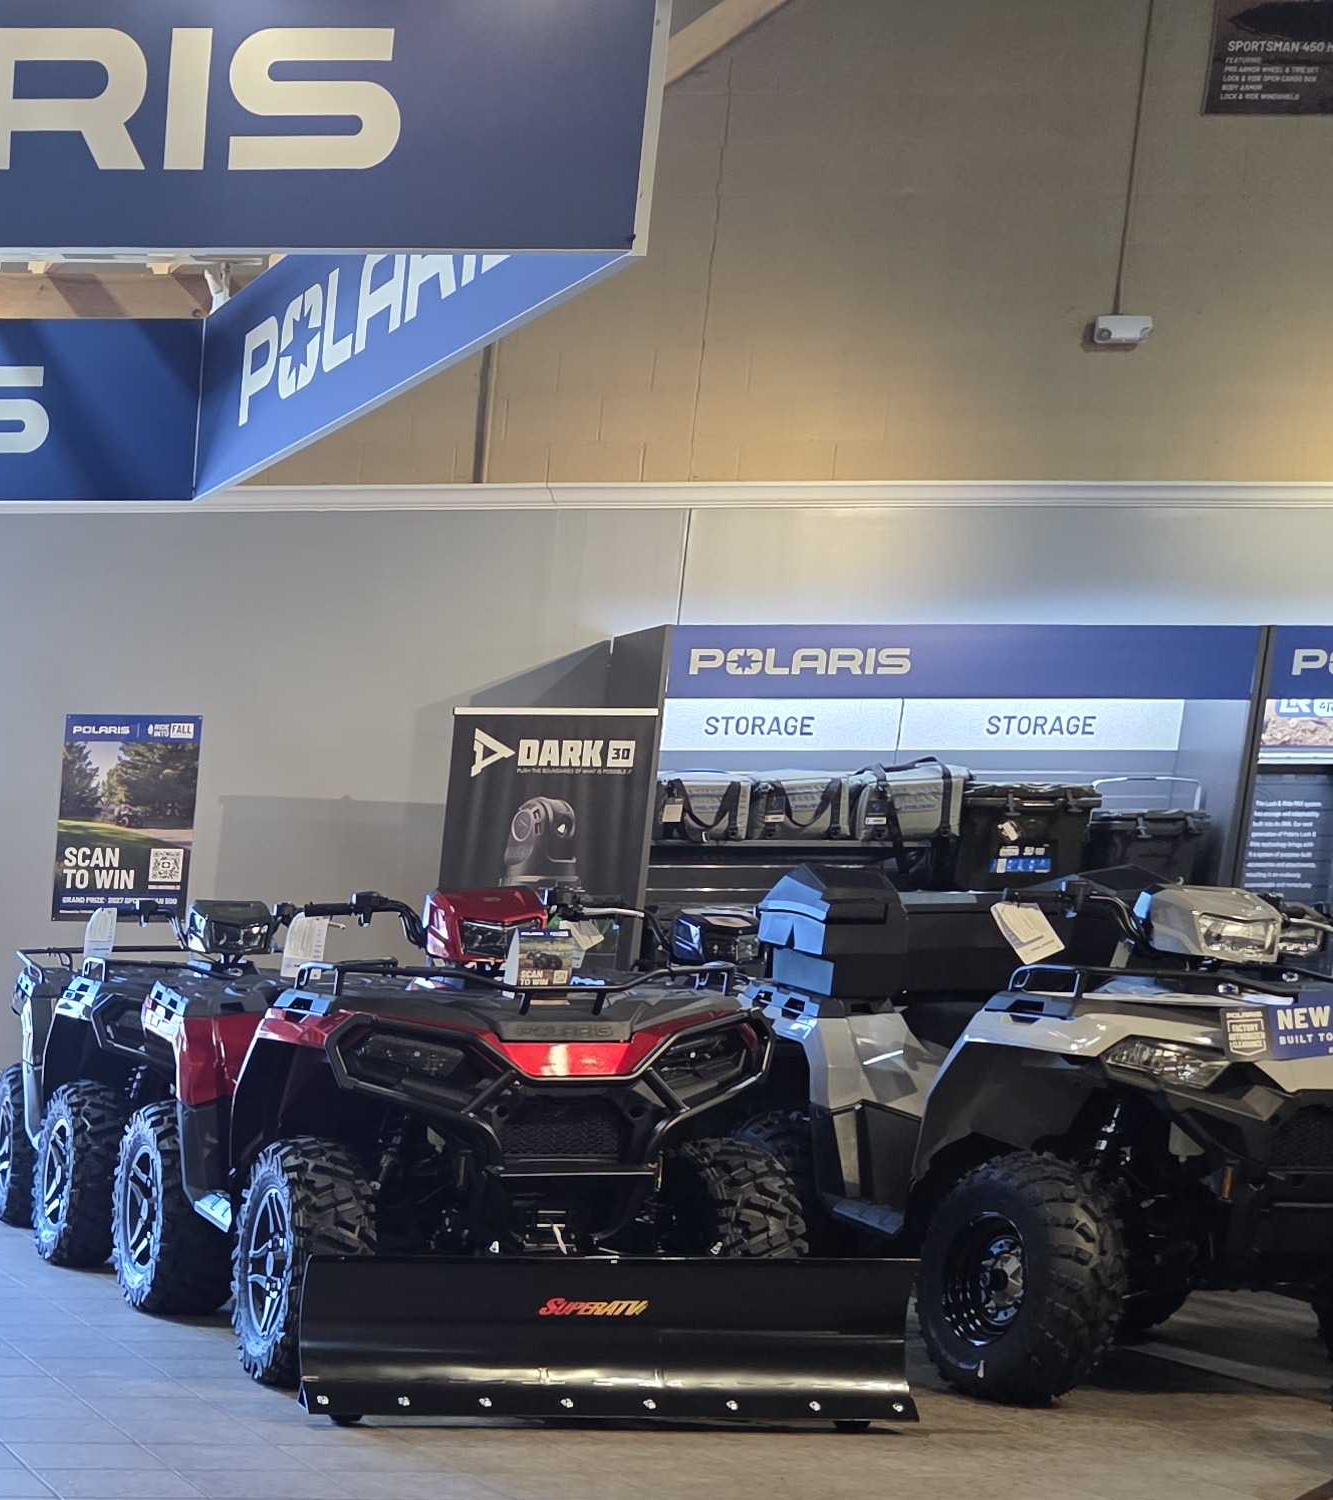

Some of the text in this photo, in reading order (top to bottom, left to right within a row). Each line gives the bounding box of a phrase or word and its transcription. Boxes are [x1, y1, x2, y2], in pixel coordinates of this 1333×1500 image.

[1227, 40, 1300, 52] SPORTSMAN
[1302, 41, 1325, 52] 450
[238, 254, 511, 427] POLAR
[689, 647, 912, 675] POLARIS
[72, 725, 130, 735] POLARIS
[172, 724, 192, 734] FALL
[704, 715, 815, 737] STORAGE
[985, 714, 1097, 736] STORAGE
[517, 738, 631, 767] DARK 30
[63, 847, 120, 868] SCAN
[62, 868, 135, 890] TO WIN
[62, 896, 85, 904] GRAND
[520, 969, 544, 979] SCAN
[520, 978, 549, 986] TO WIN
[1226, 1011, 1264, 1019] POLARIS
[1276, 1005, 1331, 1031] NEW
[517, 1024, 614, 1038] POLARIS
[1278, 1033, 1314, 1046] BUILT
[1318, 1031, 1333, 1043] TO
